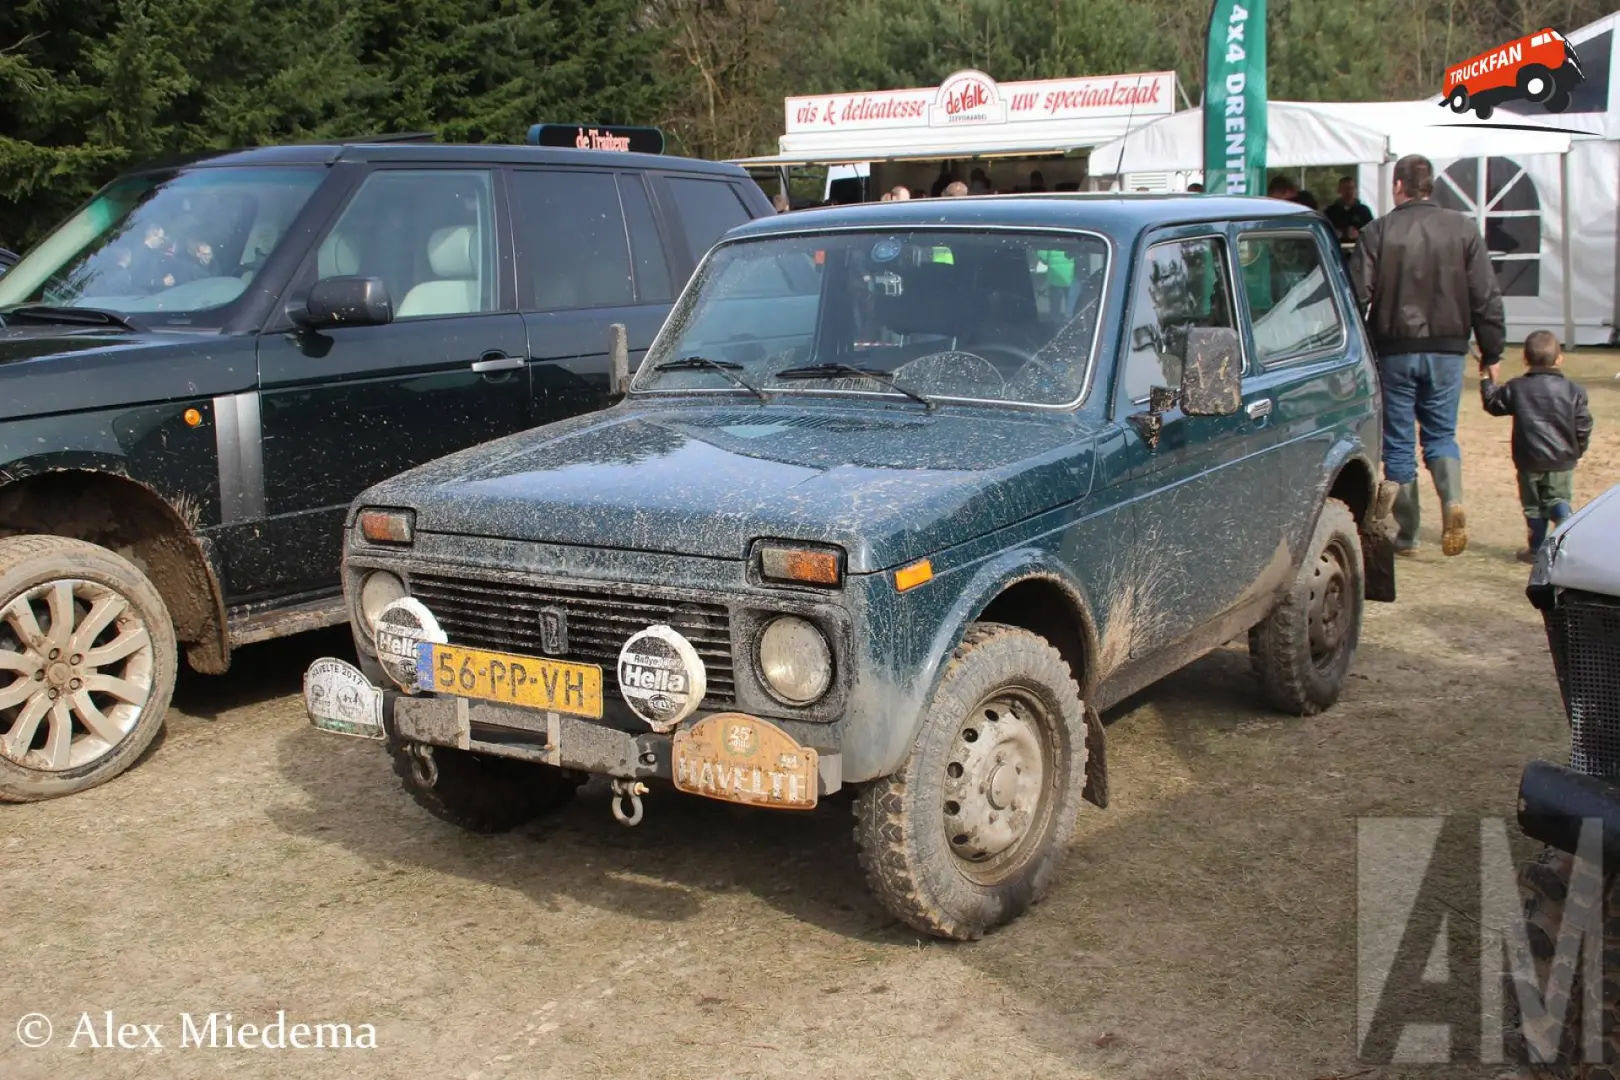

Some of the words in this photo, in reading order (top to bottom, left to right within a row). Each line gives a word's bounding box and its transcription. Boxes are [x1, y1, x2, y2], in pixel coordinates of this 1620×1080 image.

[1011, 92, 1039, 111] uw
[1044, 78, 1160, 114] speciaalzaak
[796, 101, 818, 124] vis
[822, 100, 836, 126] &
[841, 97, 926, 121] delicatesse
[576, 127, 590, 149] de
[589, 129, 631, 152] Traiteur
[341, 668, 363, 686] 2017
[440, 652, 584, 708] 56-PP-VH
[624, 664, 685, 692] Hella
[730, 725, 751, 741] 25
[678, 756, 807, 804] HAVELTE
